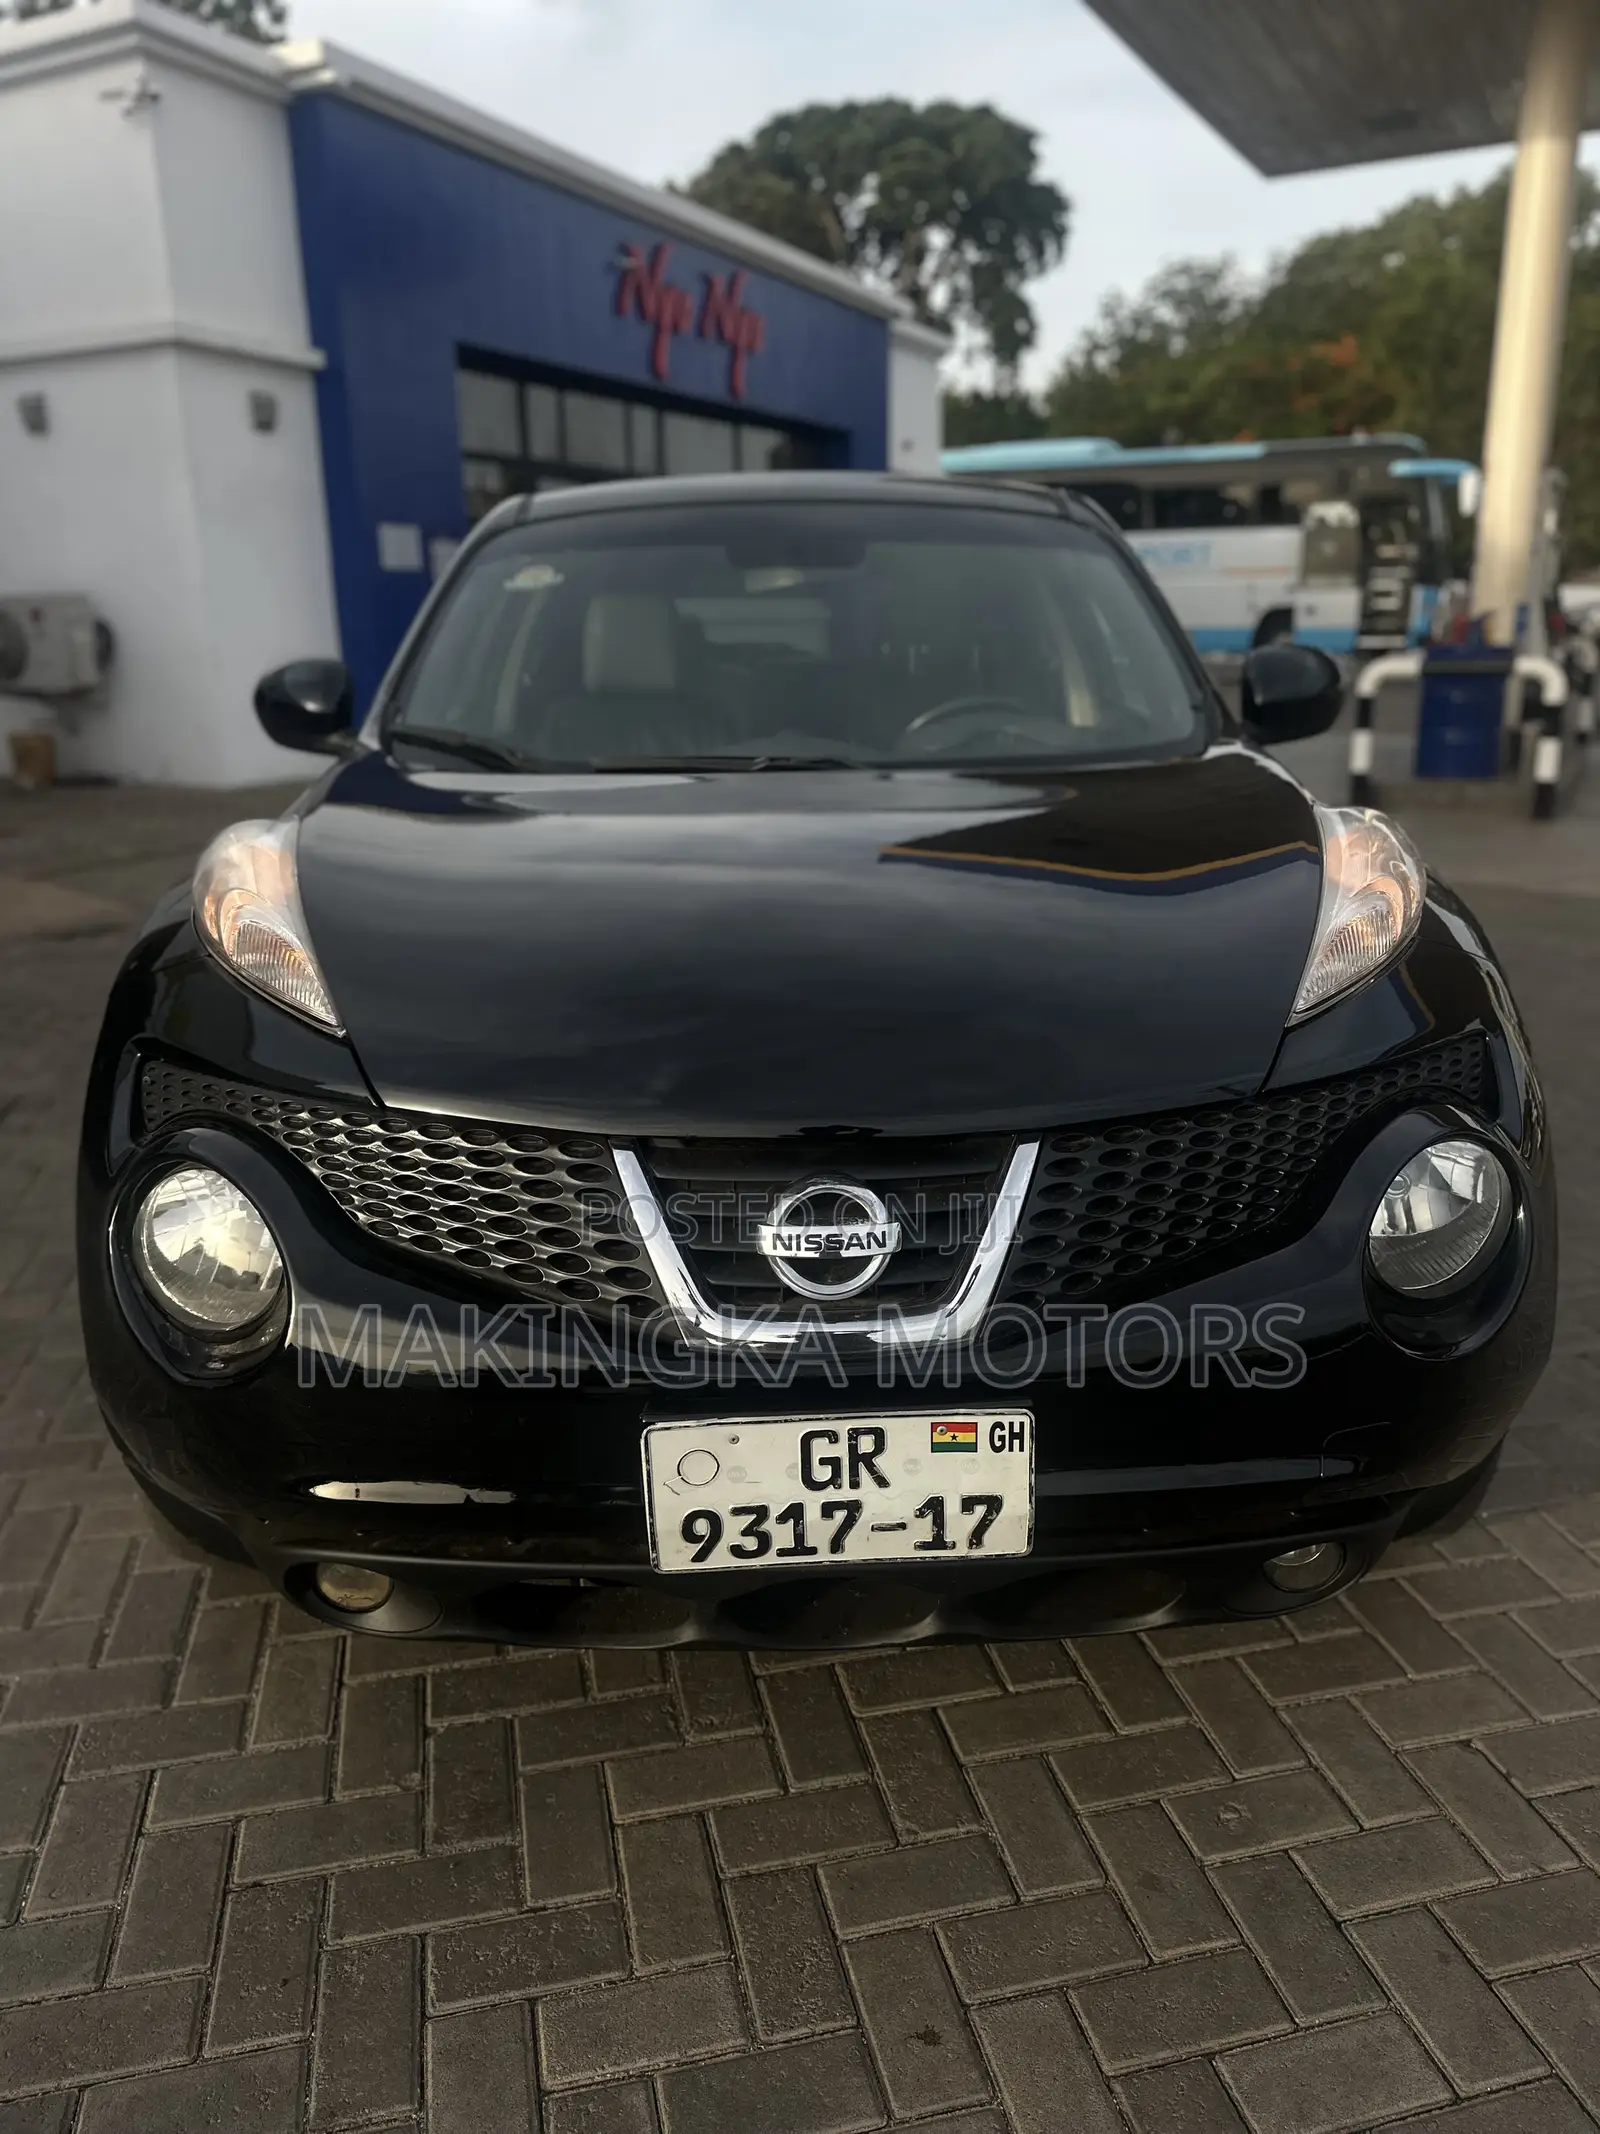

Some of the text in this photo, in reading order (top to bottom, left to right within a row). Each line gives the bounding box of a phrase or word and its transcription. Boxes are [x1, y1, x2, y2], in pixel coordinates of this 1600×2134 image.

[772, 1231, 887, 1252] NISSAN
[800, 1426, 891, 1491] GR
[988, 1421, 1025, 1453] GH
[681, 1494, 1004, 1563] 9317-17
